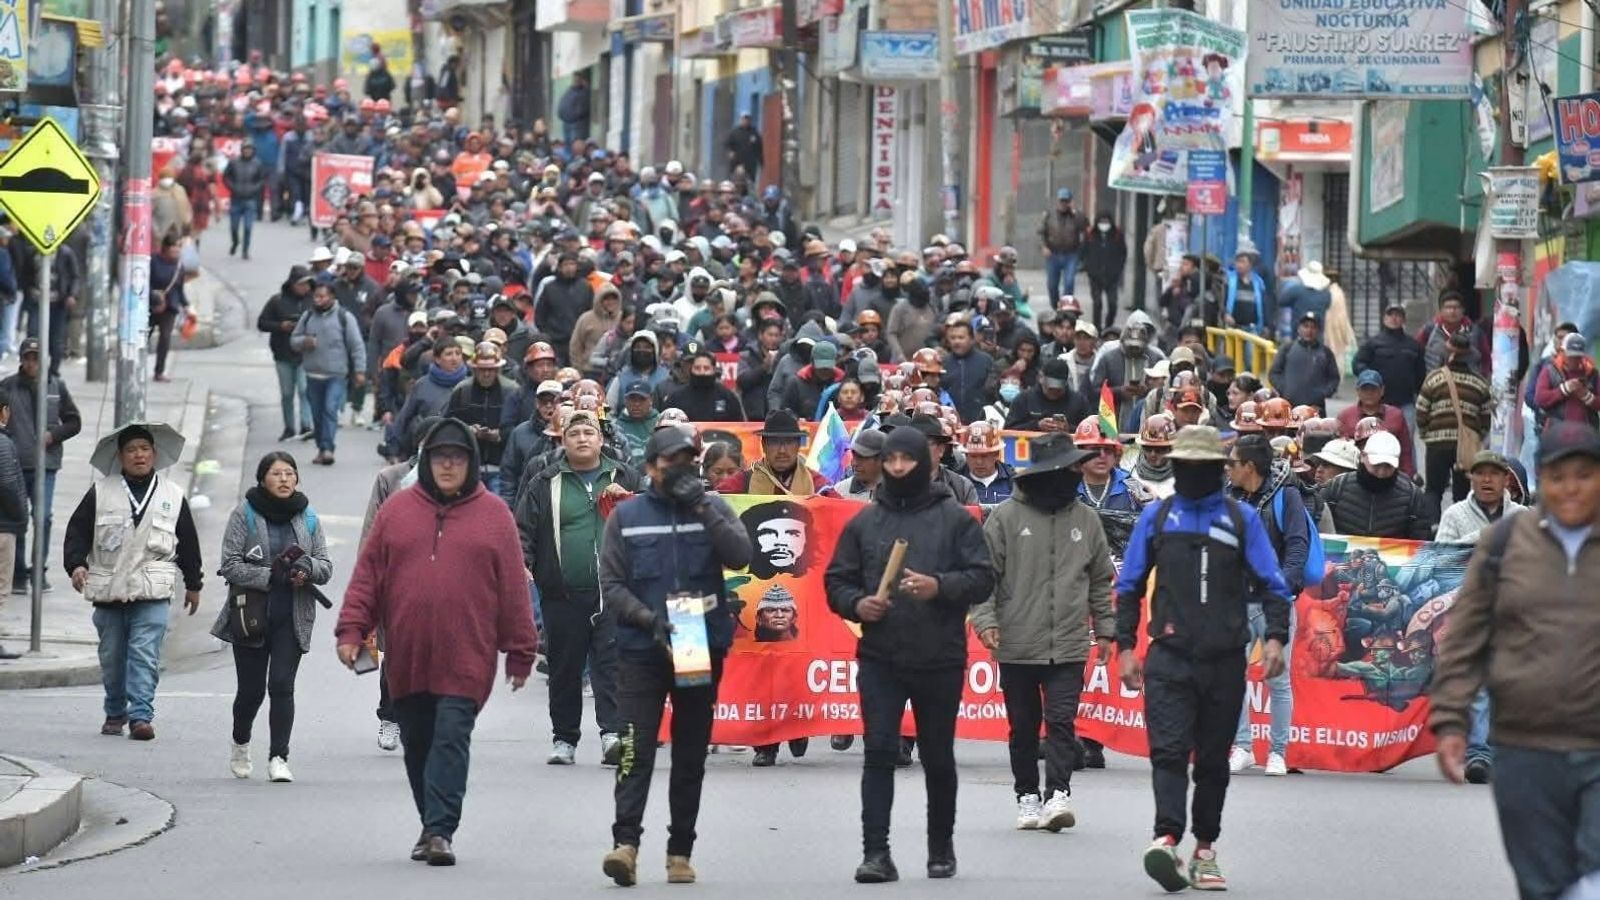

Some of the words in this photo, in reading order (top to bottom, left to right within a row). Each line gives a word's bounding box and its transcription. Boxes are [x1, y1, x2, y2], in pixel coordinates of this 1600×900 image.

[1280, 0, 1344, 9] UNIDAD
[1350, 0, 1447, 9] EDUCATIVA
[1316, 13, 1410, 28] NOCTURNA
[1283, 55, 1346, 65] PRIMARIA
[1357, 55, 1441, 66] SECUNDARIA
[1297, 132, 1332, 145] TIENDA
[875, 86, 896, 210] DENTISTA
[1083, 665, 1110, 694] A
[745, 703, 766, 721] EL
[771, 703, 788, 721] 17
[821, 703, 861, 721] 1952
[1077, 702, 1147, 729] TRABAJA
[1289, 725, 1311, 743] DE
[1316, 727, 1368, 748] ELLOS
